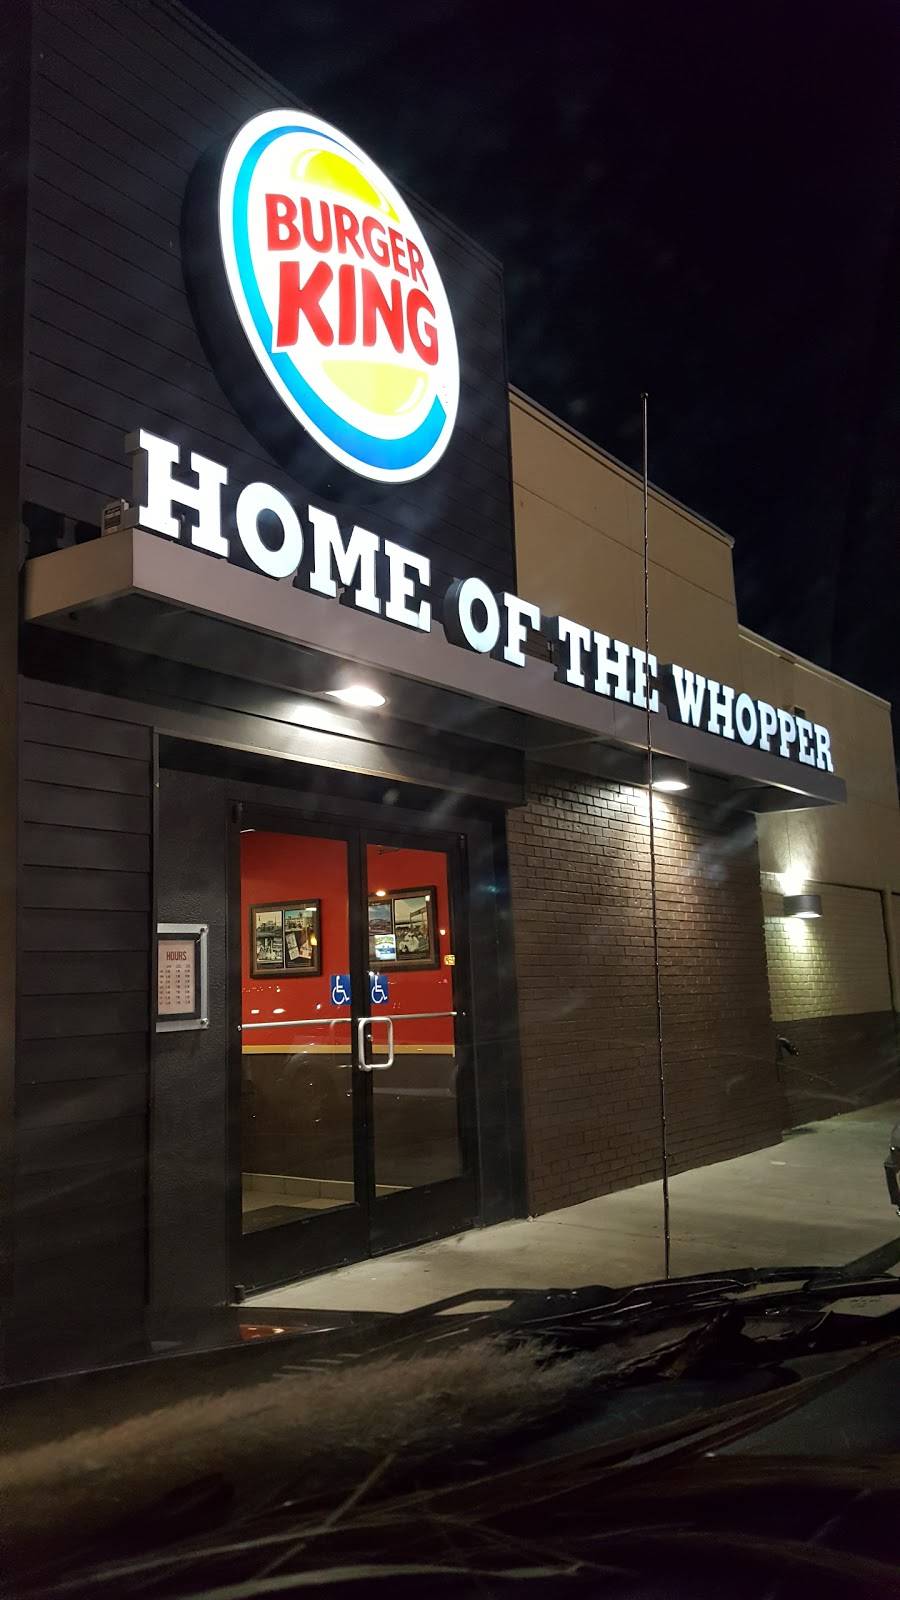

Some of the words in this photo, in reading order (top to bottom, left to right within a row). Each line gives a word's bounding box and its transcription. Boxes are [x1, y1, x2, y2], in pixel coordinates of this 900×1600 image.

[265, 193, 428, 289] BURGER
[277, 260, 439, 366] KING
[139, 429, 431, 632] HOME
[458, 577, 540, 667] OF
[558, 616, 659, 713] THE
[672, 663, 834, 773] WHOPPER
[166, 951, 187, 961] HOURS
